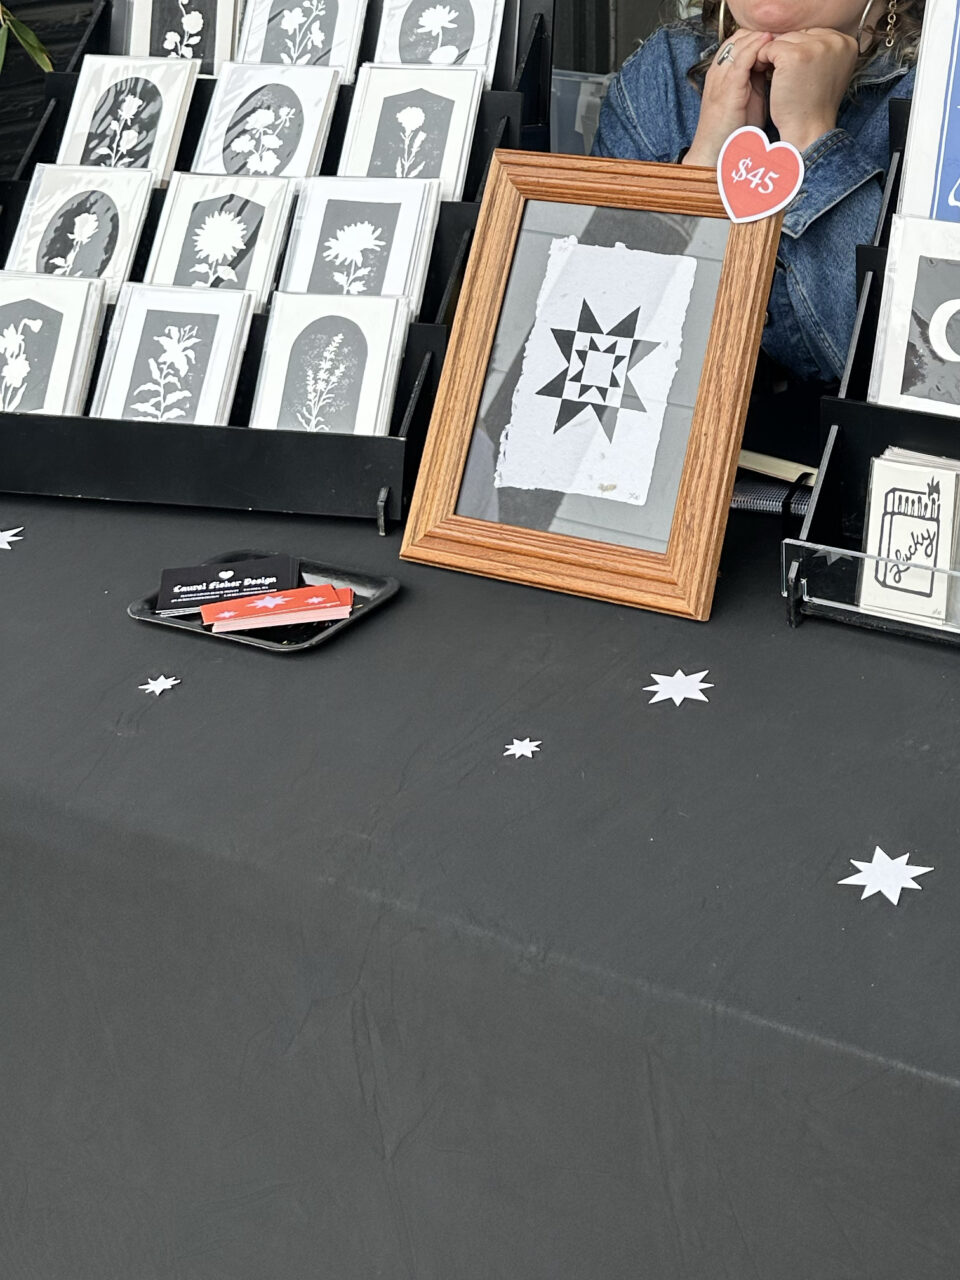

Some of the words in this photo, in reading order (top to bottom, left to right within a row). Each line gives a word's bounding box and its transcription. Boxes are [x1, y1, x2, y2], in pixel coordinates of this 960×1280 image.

[731, 156, 780, 194] $45
[173, 582, 207, 593] Laurel
[243, 576, 277, 586] Design
